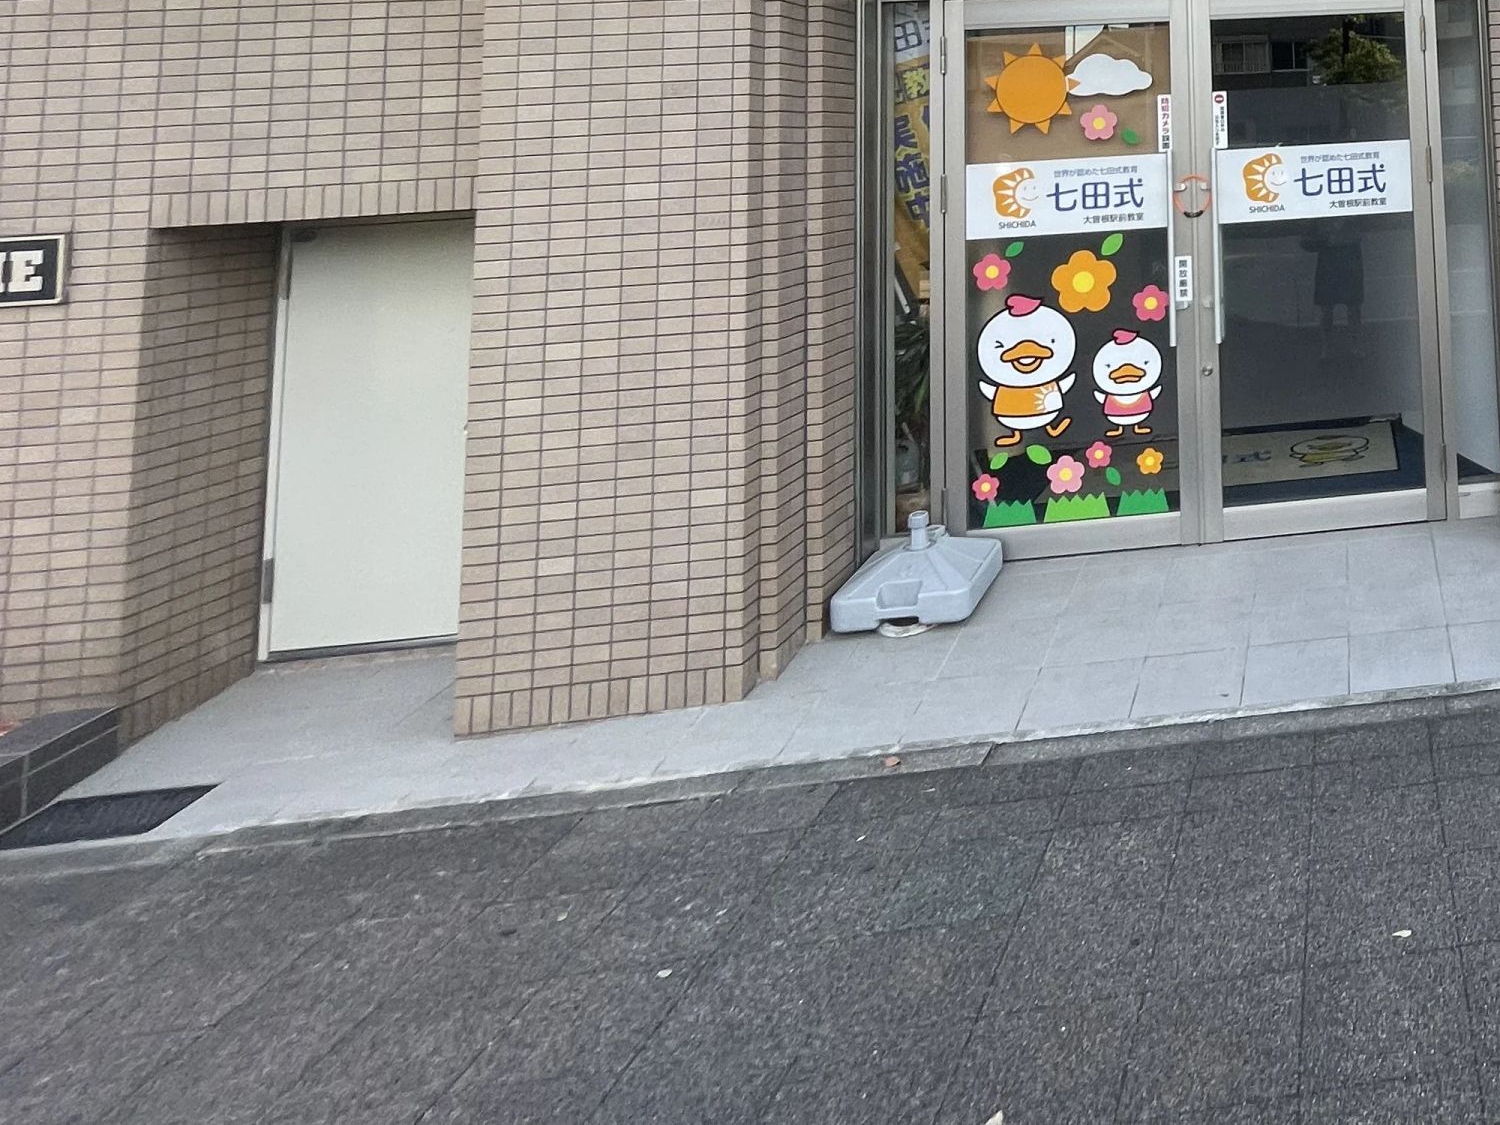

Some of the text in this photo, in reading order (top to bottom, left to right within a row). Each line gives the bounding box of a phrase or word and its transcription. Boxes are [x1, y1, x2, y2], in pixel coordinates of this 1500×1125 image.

[1046, 177, 1144, 212] 七田式
[1293, 163, 1386, 196] 七田式
